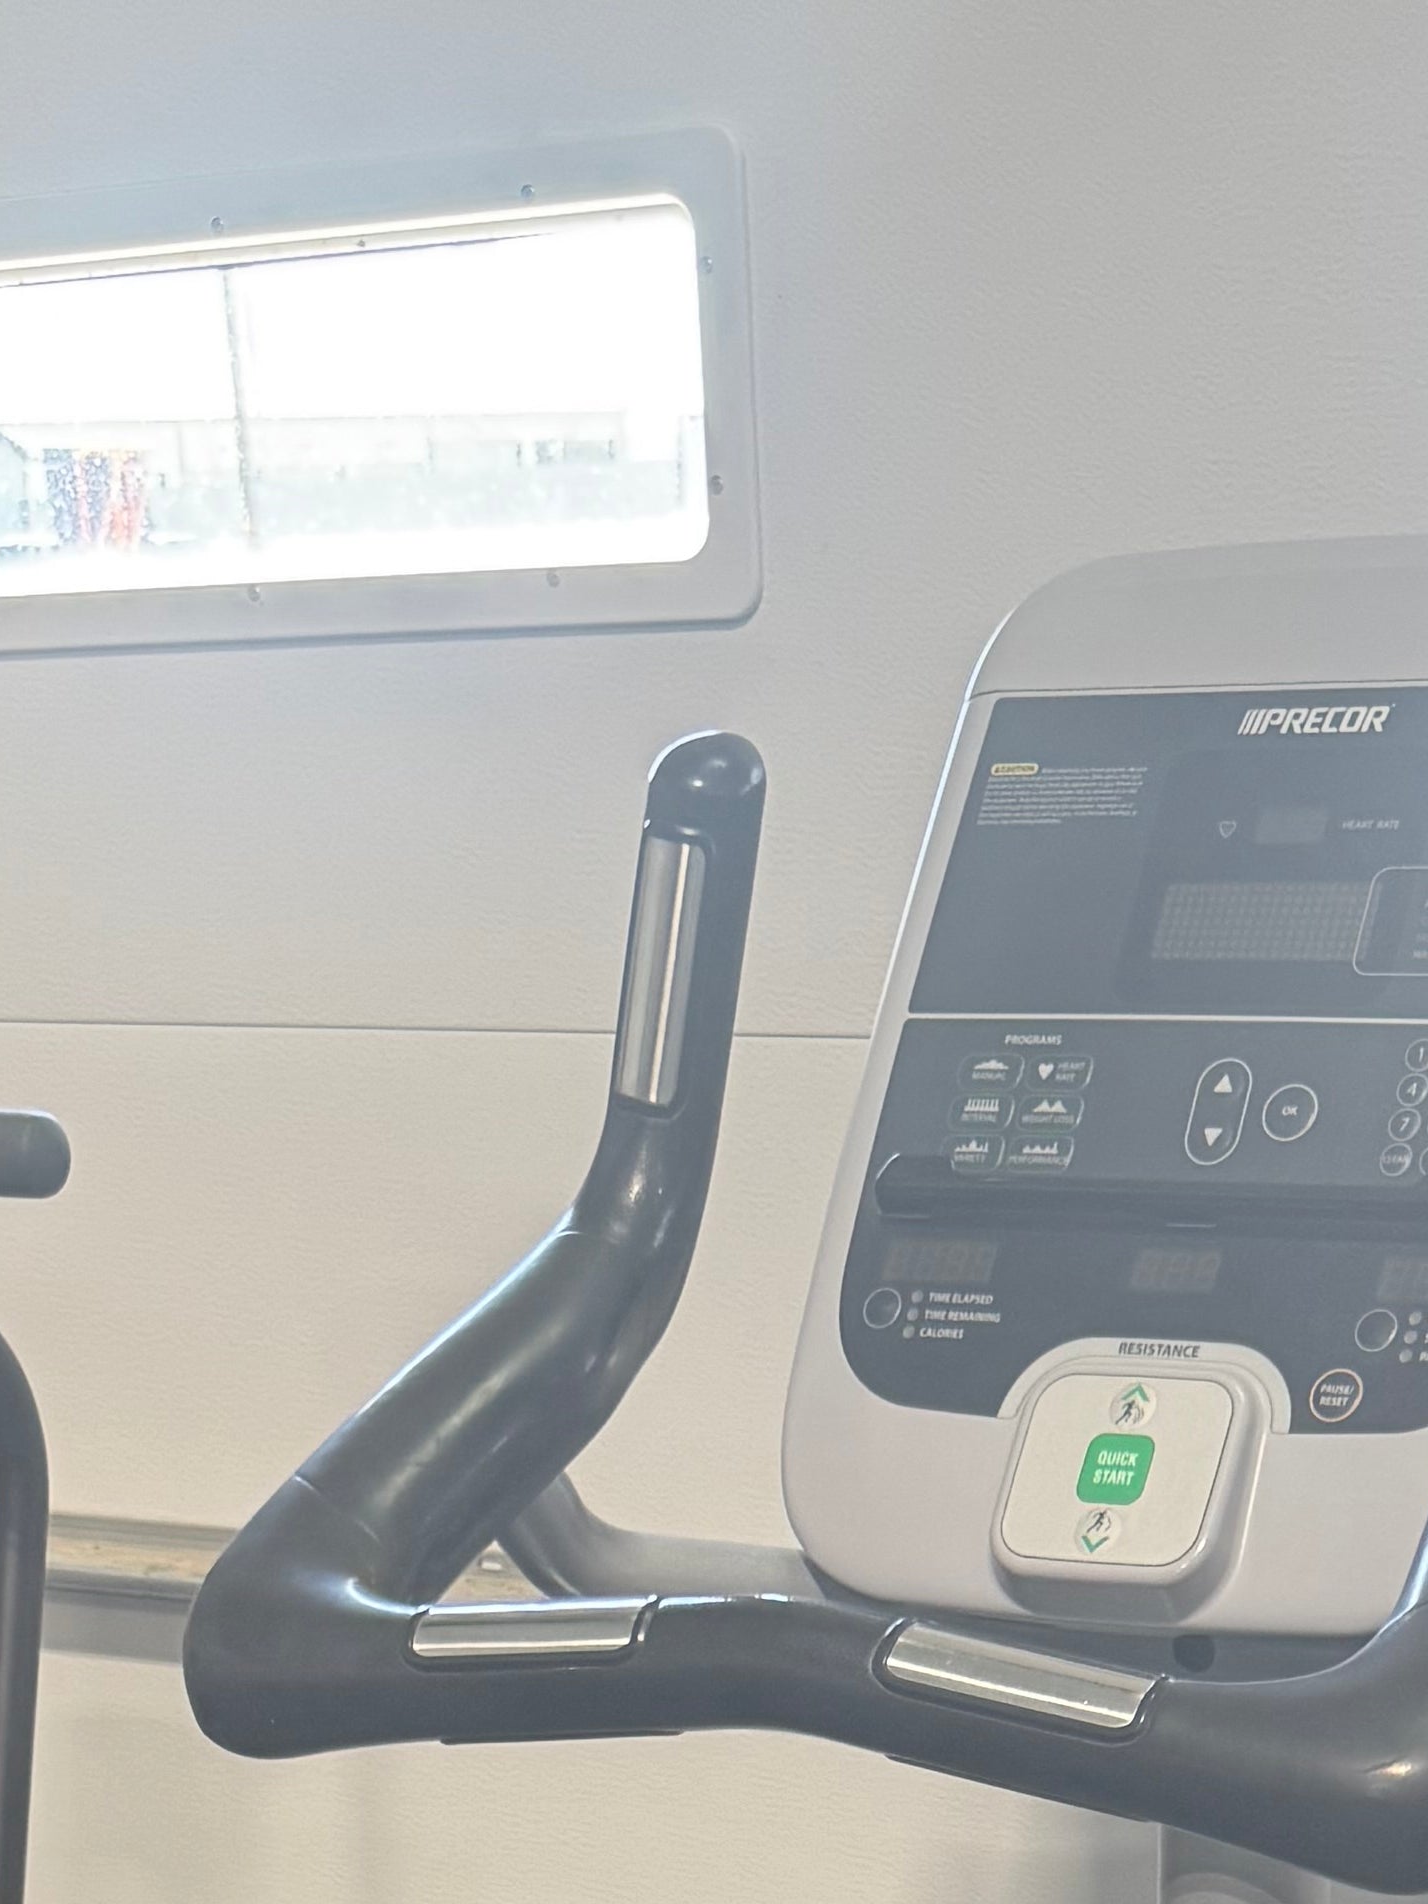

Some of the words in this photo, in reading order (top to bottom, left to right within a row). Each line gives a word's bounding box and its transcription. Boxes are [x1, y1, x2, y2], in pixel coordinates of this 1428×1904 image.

[1256, 706, 1390, 735] PRECOR
[1342, 819, 1374, 830] HEART
[1376, 819, 1400, 830] RATE
[1004, 1034, 1062, 1046] PROGRAMS
[1407, 1082, 1418, 1096] 4
[1282, 1105, 1298, 1116] OK
[1399, 1117, 1410, 1131] 7
[929, 1292, 951, 1303] TIME
[952, 1293, 994, 1305] ELAPSED
[925, 1309, 947, 1321] TIME
[948, 1311, 1001, 1323] REMAINING
[919, 1327, 964, 1339] CALORIES
[1118, 1342, 1201, 1358] RESISTANCE
[1319, 1396, 1350, 1407] RESET
[1097, 1450, 1139, 1467] QUICK
[1092, 1468, 1135, 1486] START
